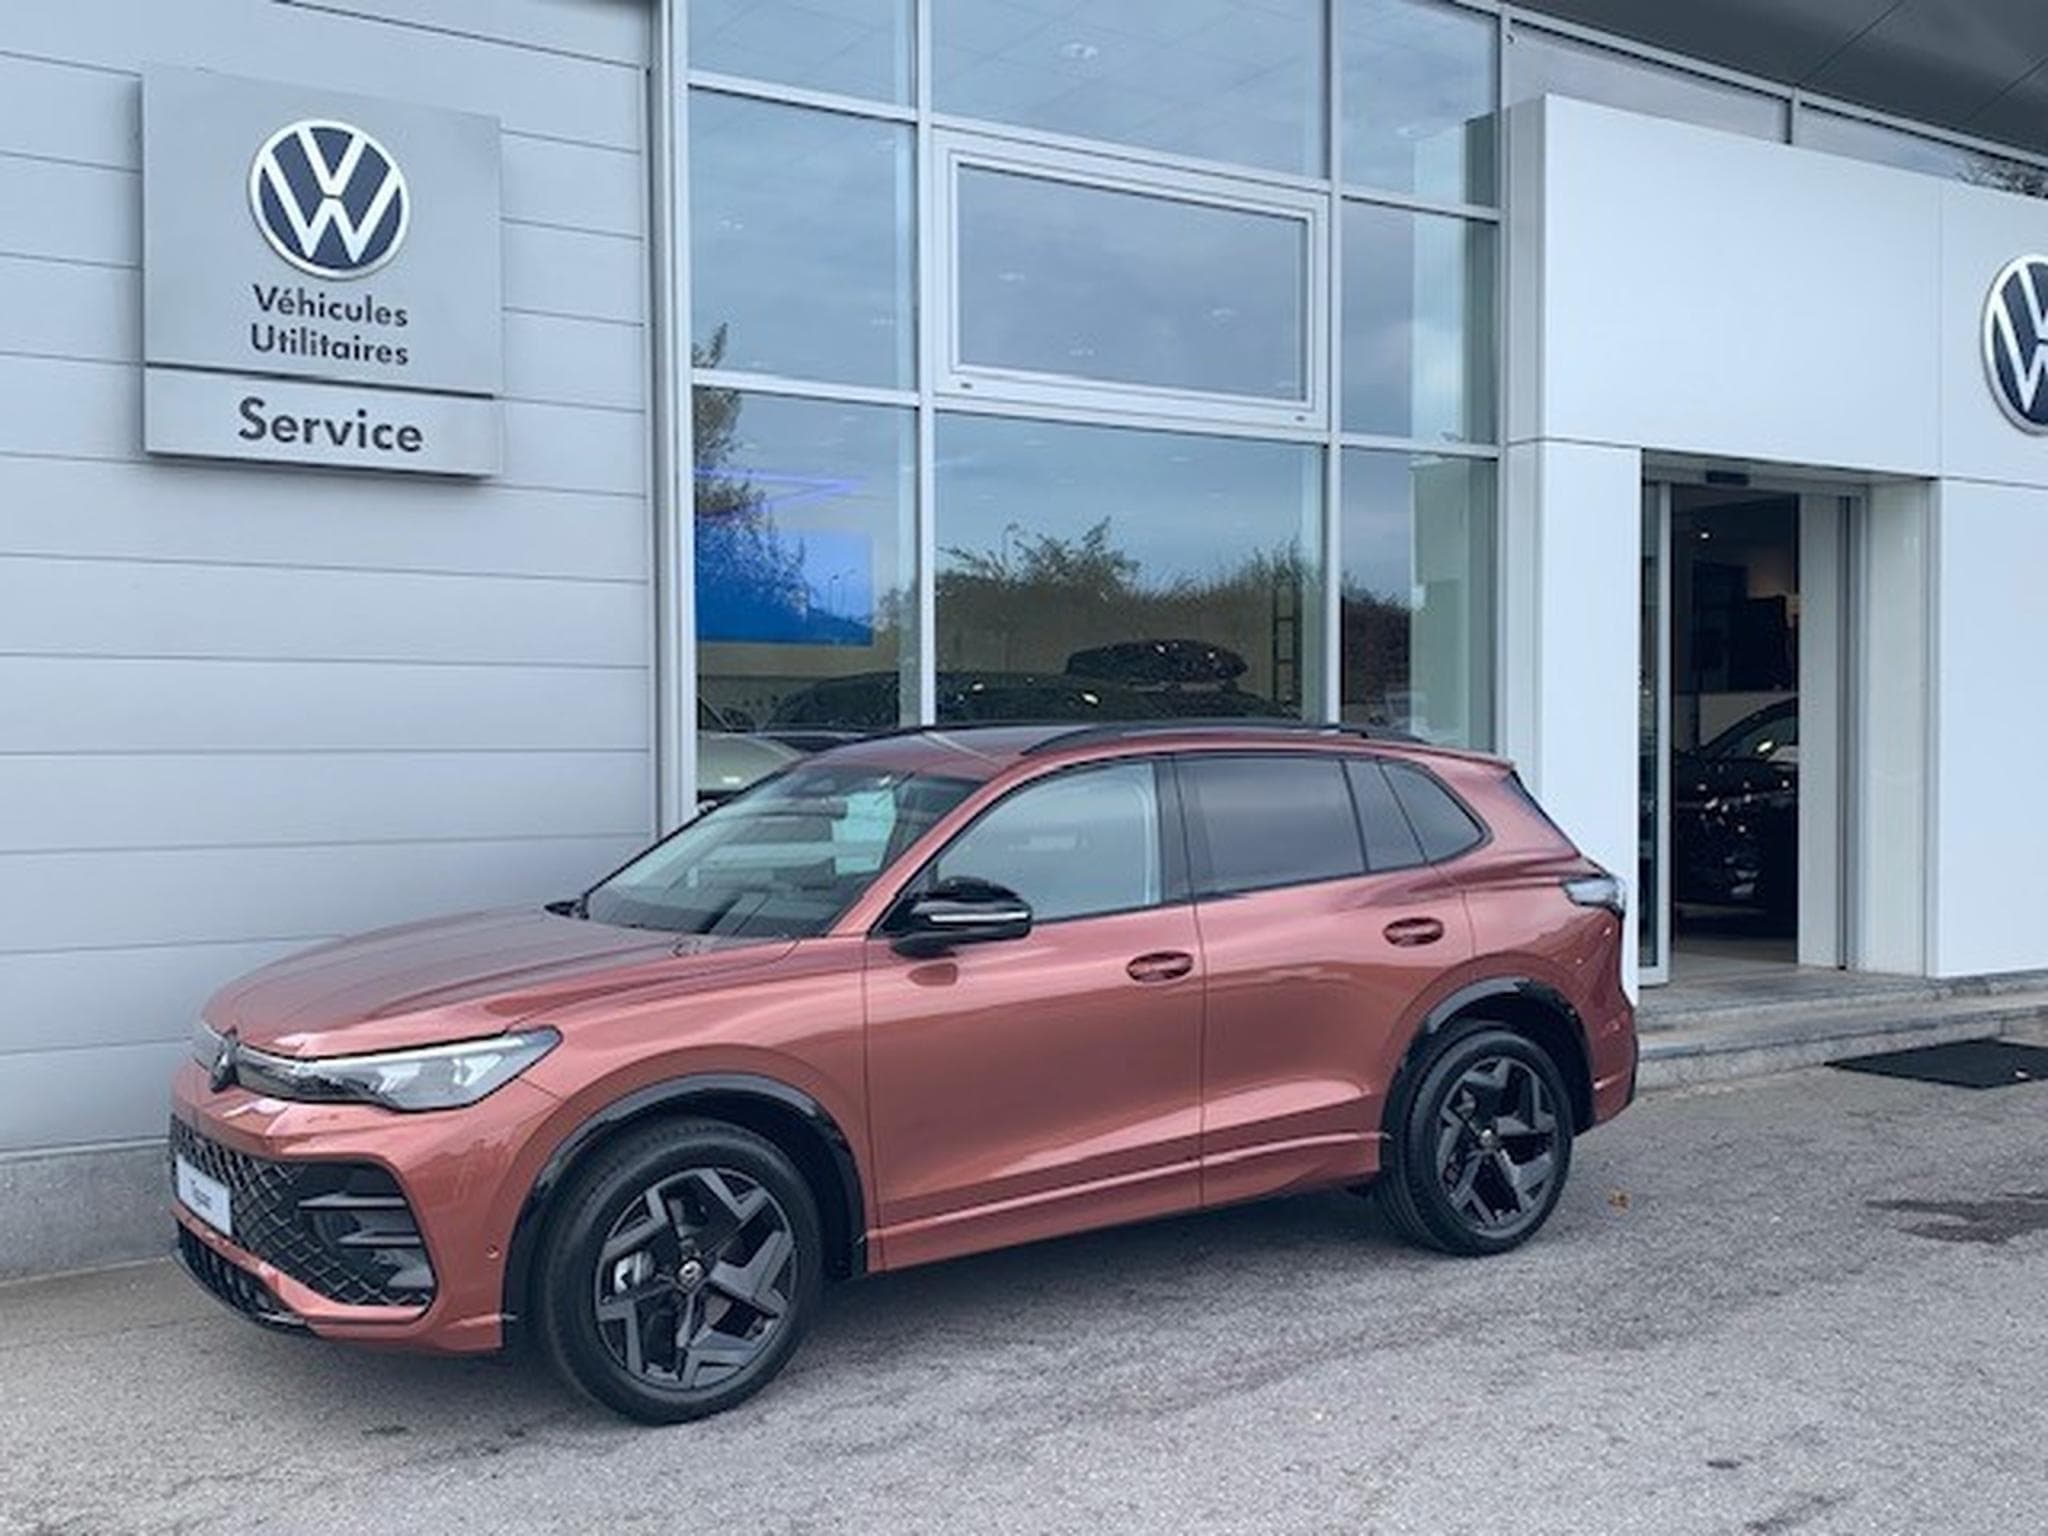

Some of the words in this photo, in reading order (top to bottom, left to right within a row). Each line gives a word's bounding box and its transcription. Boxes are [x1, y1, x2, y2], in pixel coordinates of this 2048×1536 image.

[256, 123, 404, 267] VW
[252, 284, 409, 327] Véhicules
[251, 324, 409, 366] Utilitaires
[238, 397, 424, 453] Service
